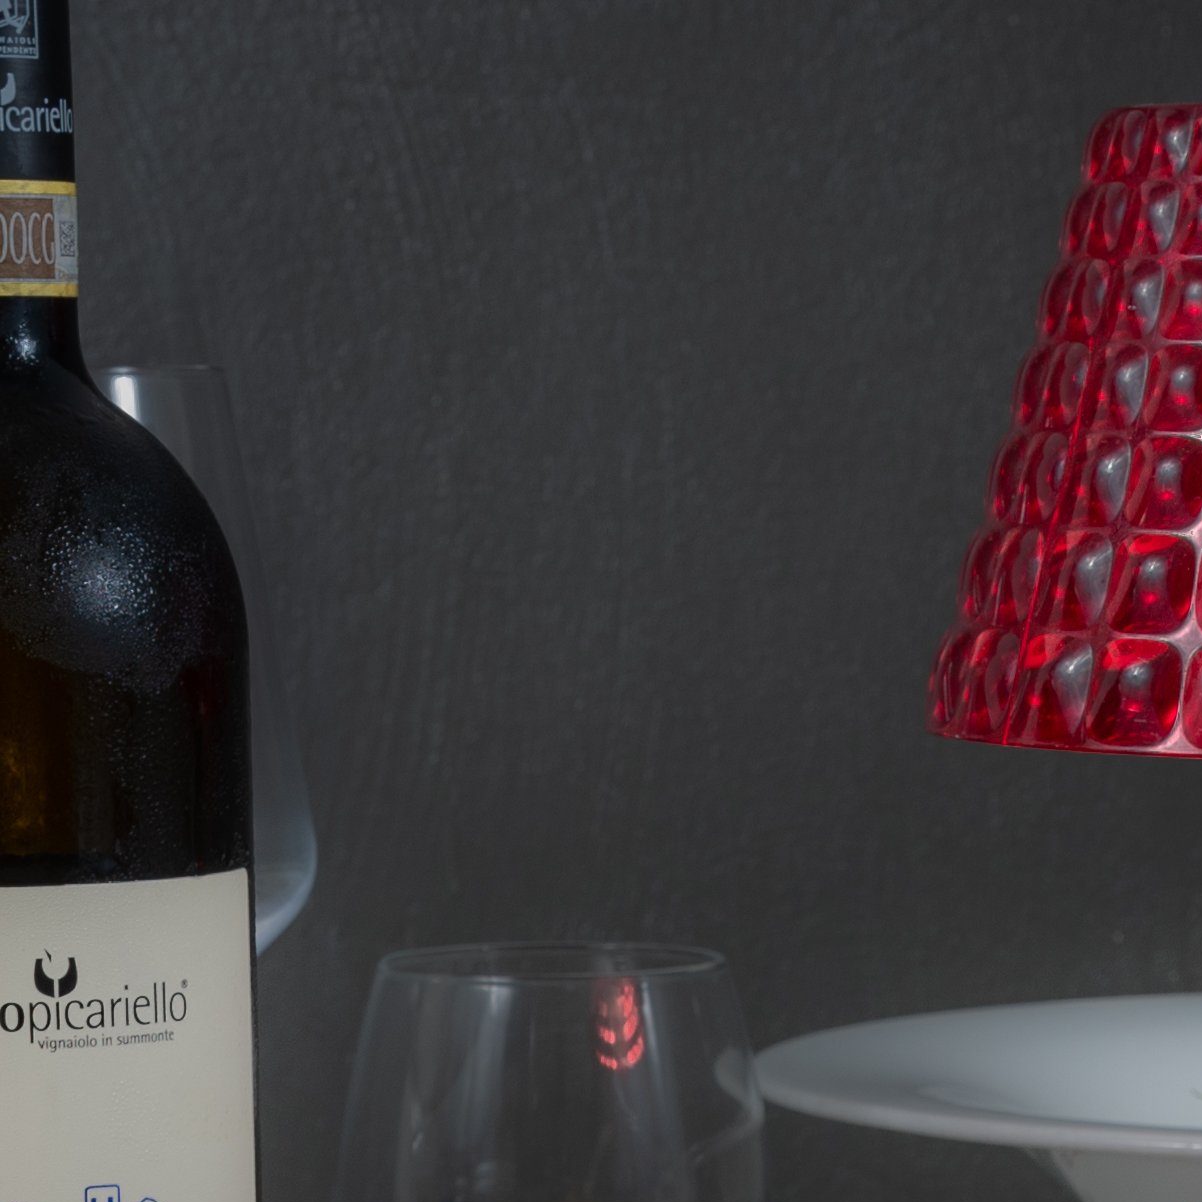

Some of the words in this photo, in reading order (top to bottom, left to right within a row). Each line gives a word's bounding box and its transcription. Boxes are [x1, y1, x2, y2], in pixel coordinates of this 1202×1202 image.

[38, 1034, 97, 1053] vignaiolo
[101, 1033, 113, 1047] in
[116, 1030, 174, 1046] summonte
